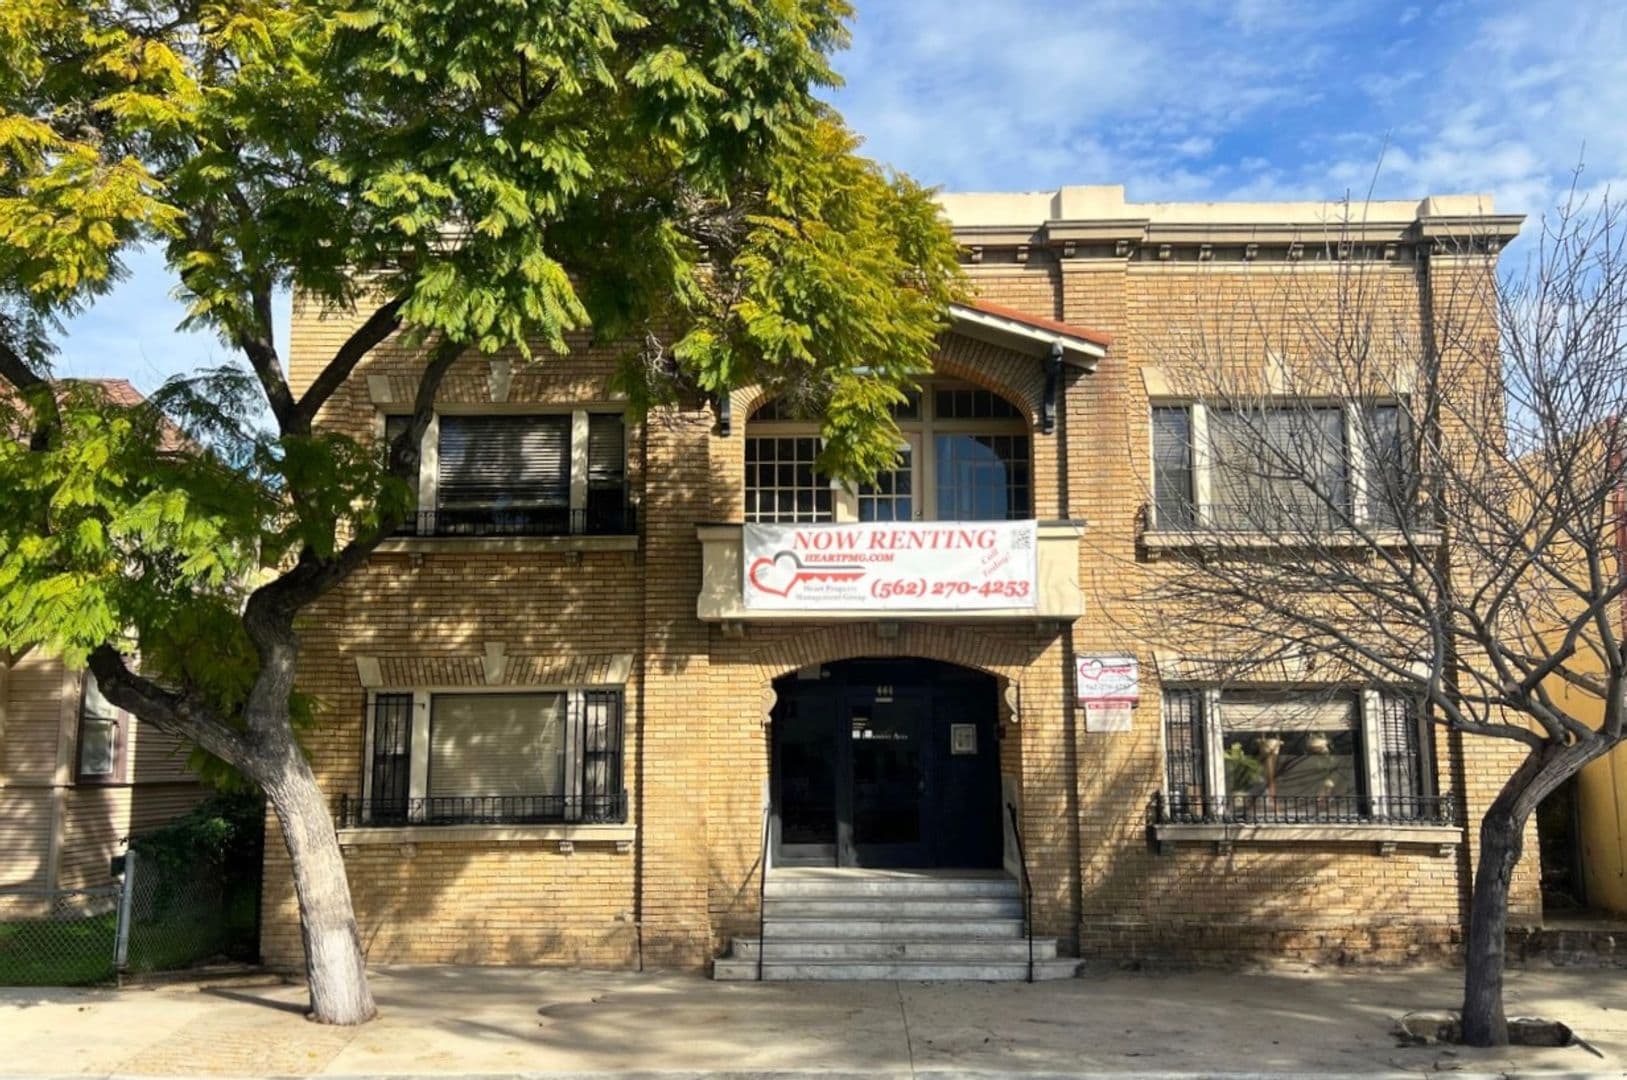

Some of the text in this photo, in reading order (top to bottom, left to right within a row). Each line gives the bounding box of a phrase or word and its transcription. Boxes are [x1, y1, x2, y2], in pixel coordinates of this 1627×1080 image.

[793, 528, 997, 550] NOW RENTING
[804, 553, 894, 563] HEARTPMG.COM
[871, 578, 1030, 599] (562) 270-4253
